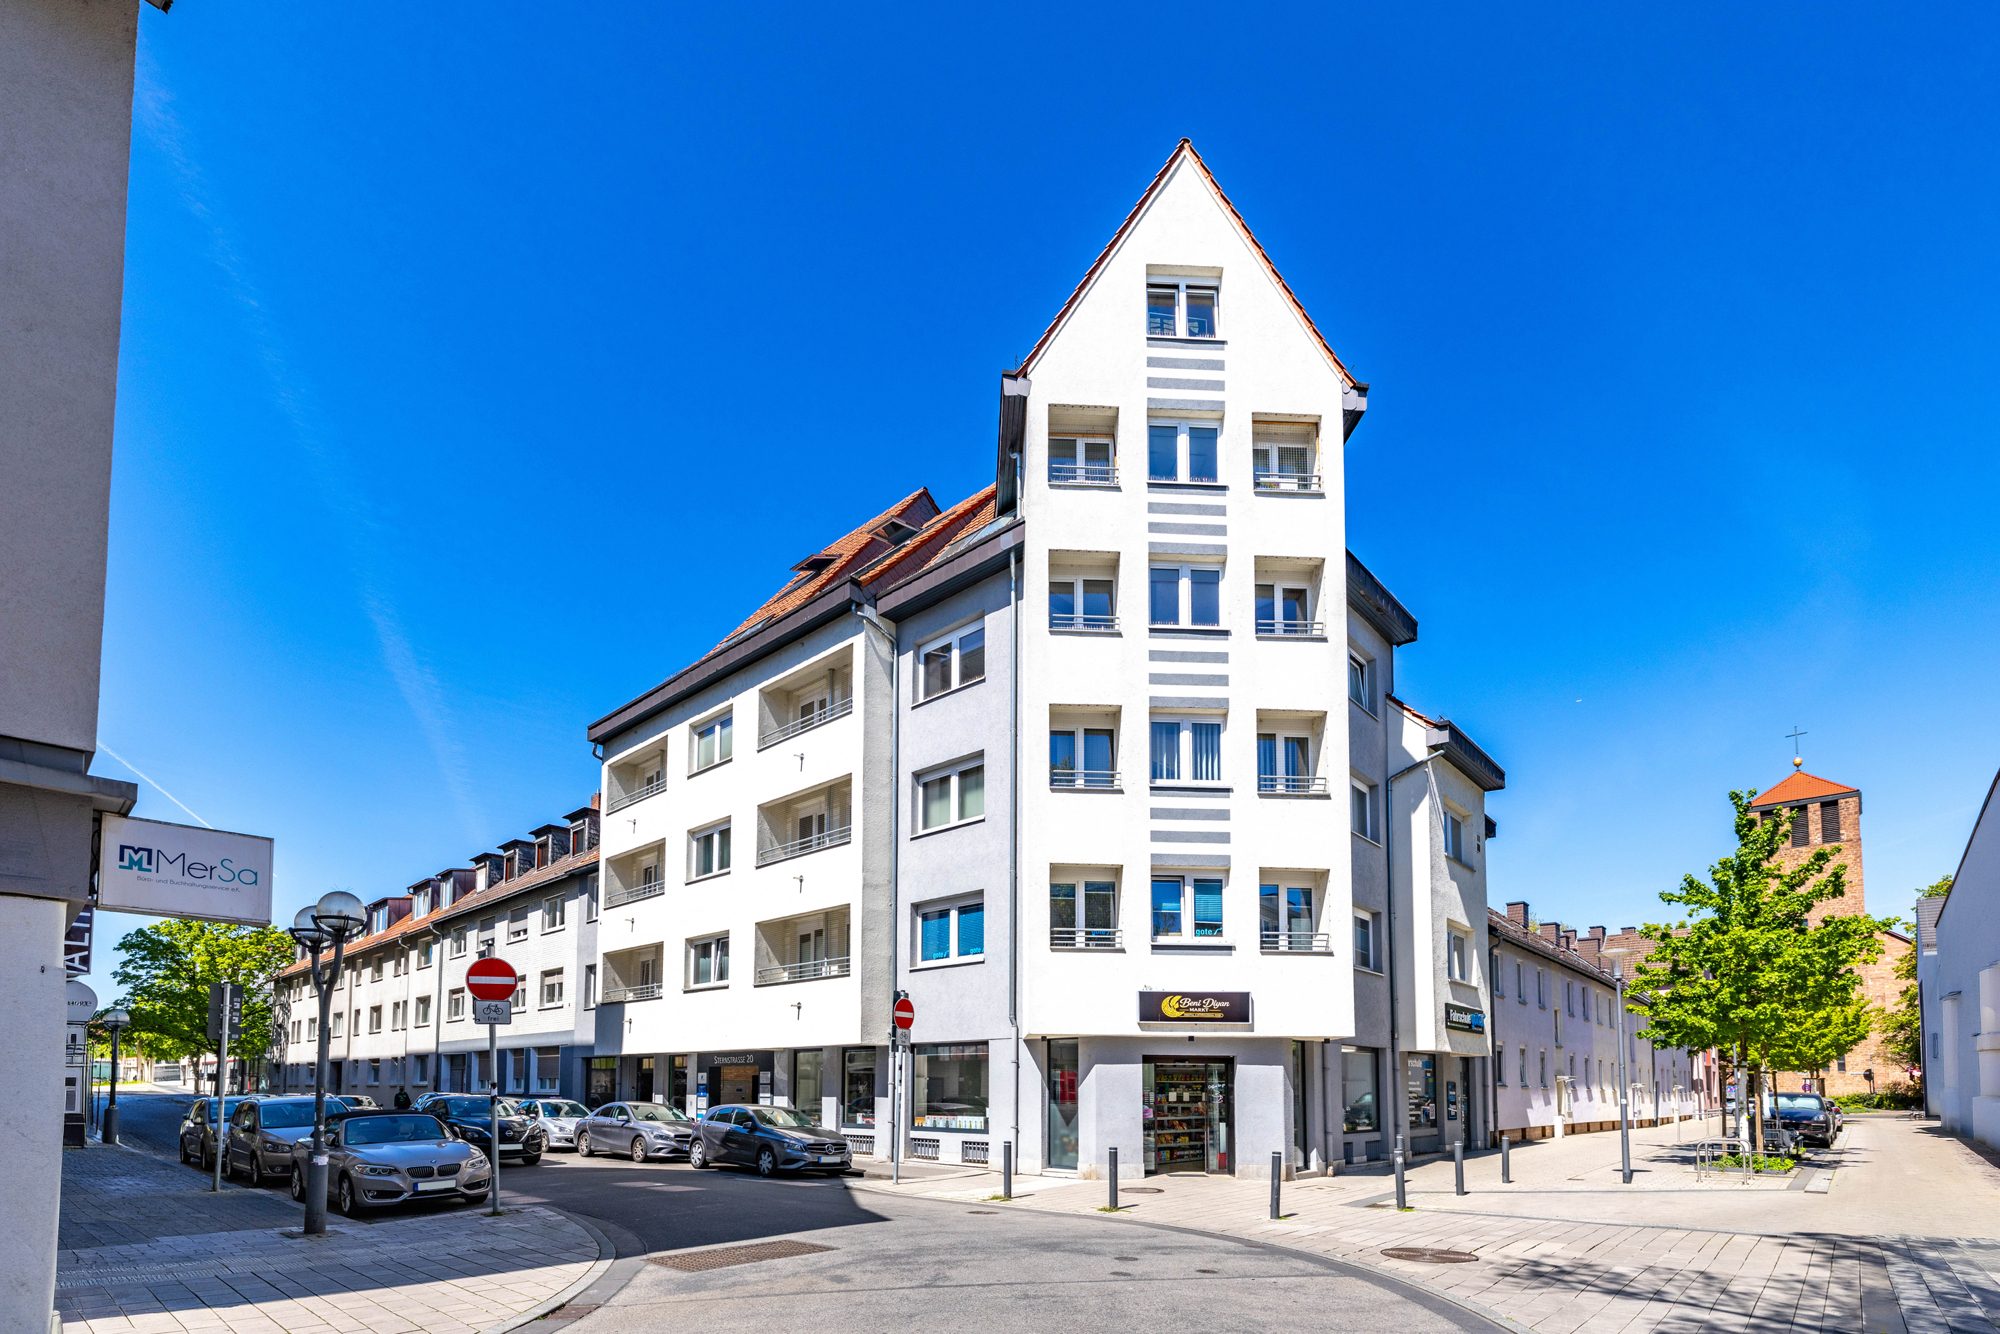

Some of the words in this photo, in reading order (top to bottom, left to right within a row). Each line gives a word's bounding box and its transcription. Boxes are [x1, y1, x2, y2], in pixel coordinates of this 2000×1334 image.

[156, 849, 258, 886] MerSa
[1180, 998, 1201, 1008] Beni
[747, 1055, 754, 1063] 20
